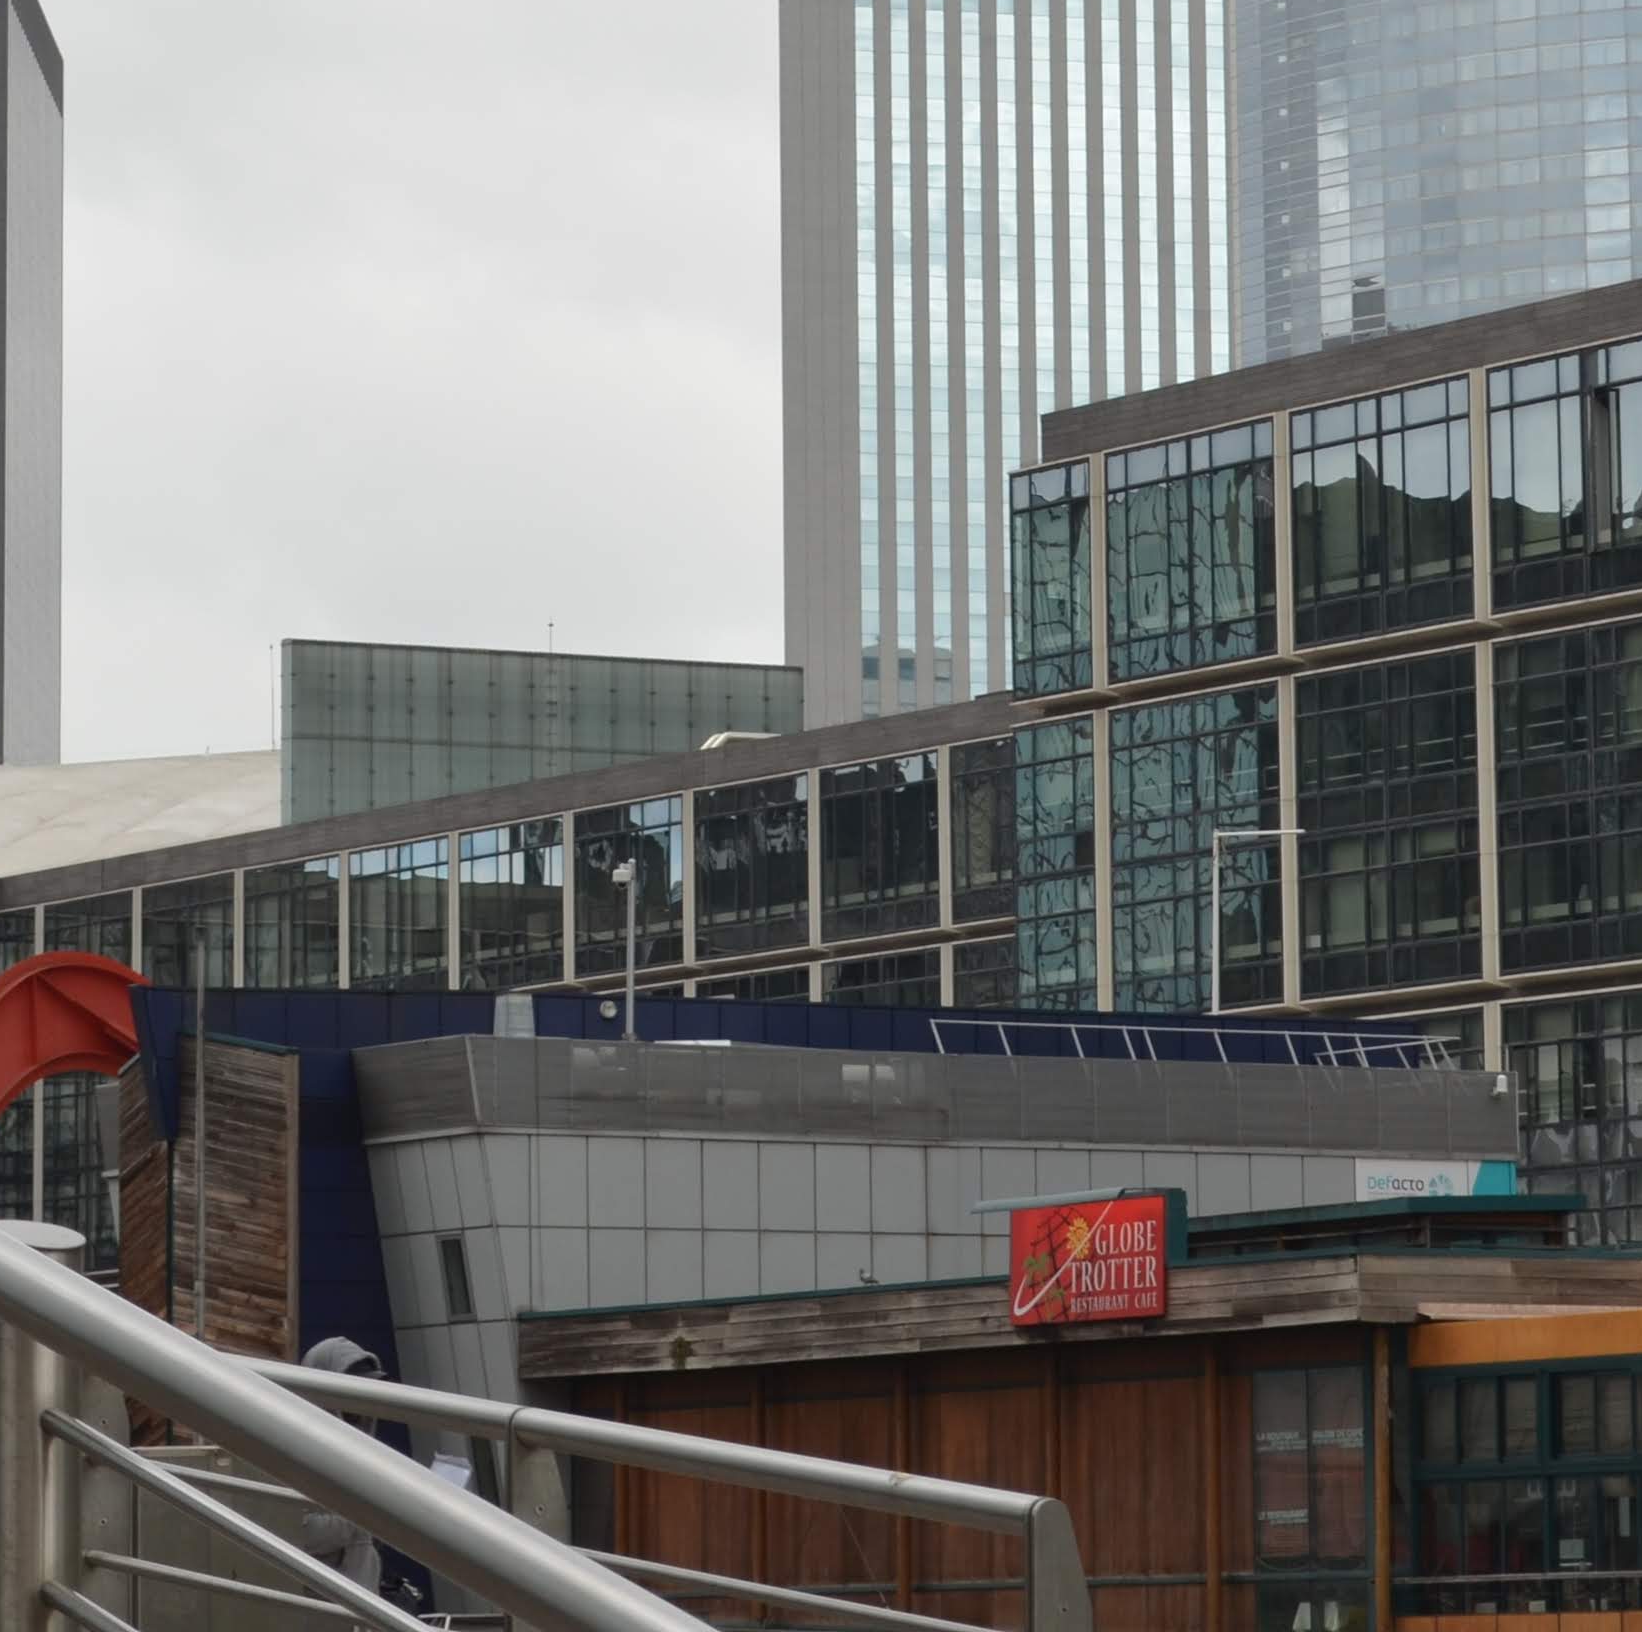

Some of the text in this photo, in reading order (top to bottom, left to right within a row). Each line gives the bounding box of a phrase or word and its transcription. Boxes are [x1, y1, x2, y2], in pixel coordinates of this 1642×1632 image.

[1095, 1220, 1157, 1255] GLOBE
[1069, 1256, 1157, 1294] TROTTER
[1070, 1294, 1129, 1313] RESTAURANT
